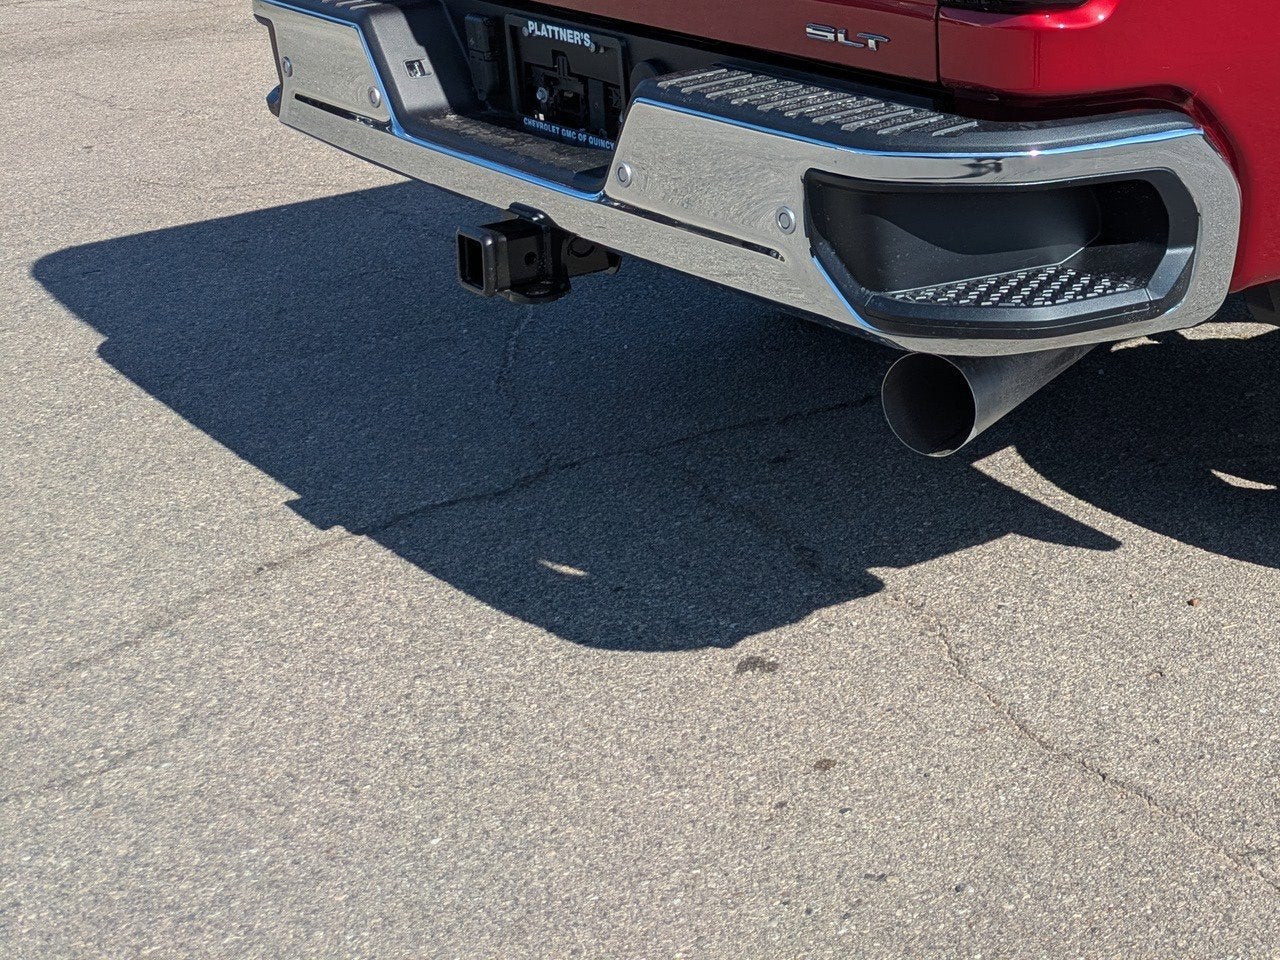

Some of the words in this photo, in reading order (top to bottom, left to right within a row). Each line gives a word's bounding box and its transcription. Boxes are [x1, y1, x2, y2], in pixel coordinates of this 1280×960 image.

[527, 20, 592, 48] PLATTNER'S
[805, 22, 890, 52] SLT
[523, 116, 560, 135] CHEVROLET
[561, 127, 577, 141] GMC
[577, 132, 588, 142] OF
[588, 134, 616, 151] QUINCY
